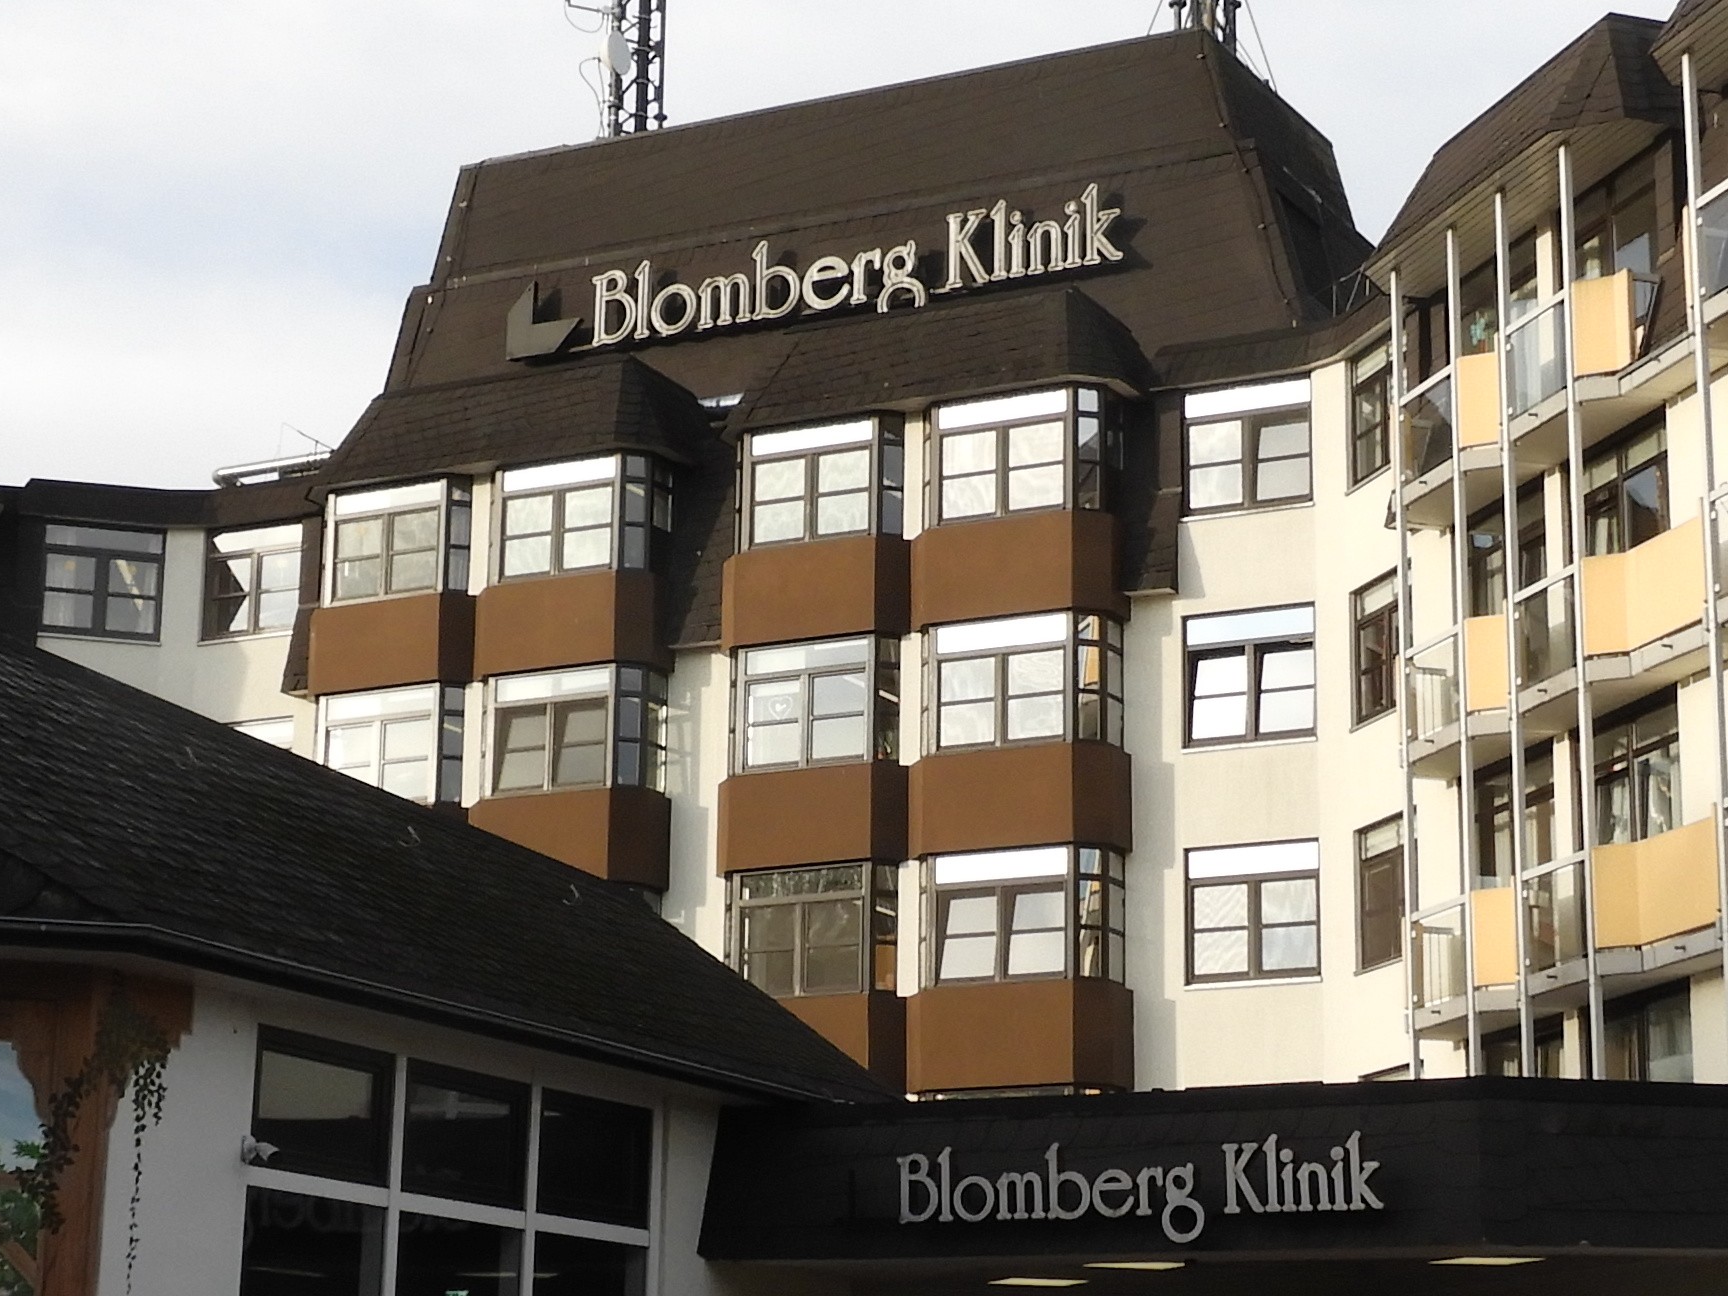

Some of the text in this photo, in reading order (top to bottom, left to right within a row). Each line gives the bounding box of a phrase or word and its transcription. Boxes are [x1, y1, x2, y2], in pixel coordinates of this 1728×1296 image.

[592, 183, 1124, 347] Blomberg Klinik
[896, 1131, 1385, 1244] Blomberg Klinik
